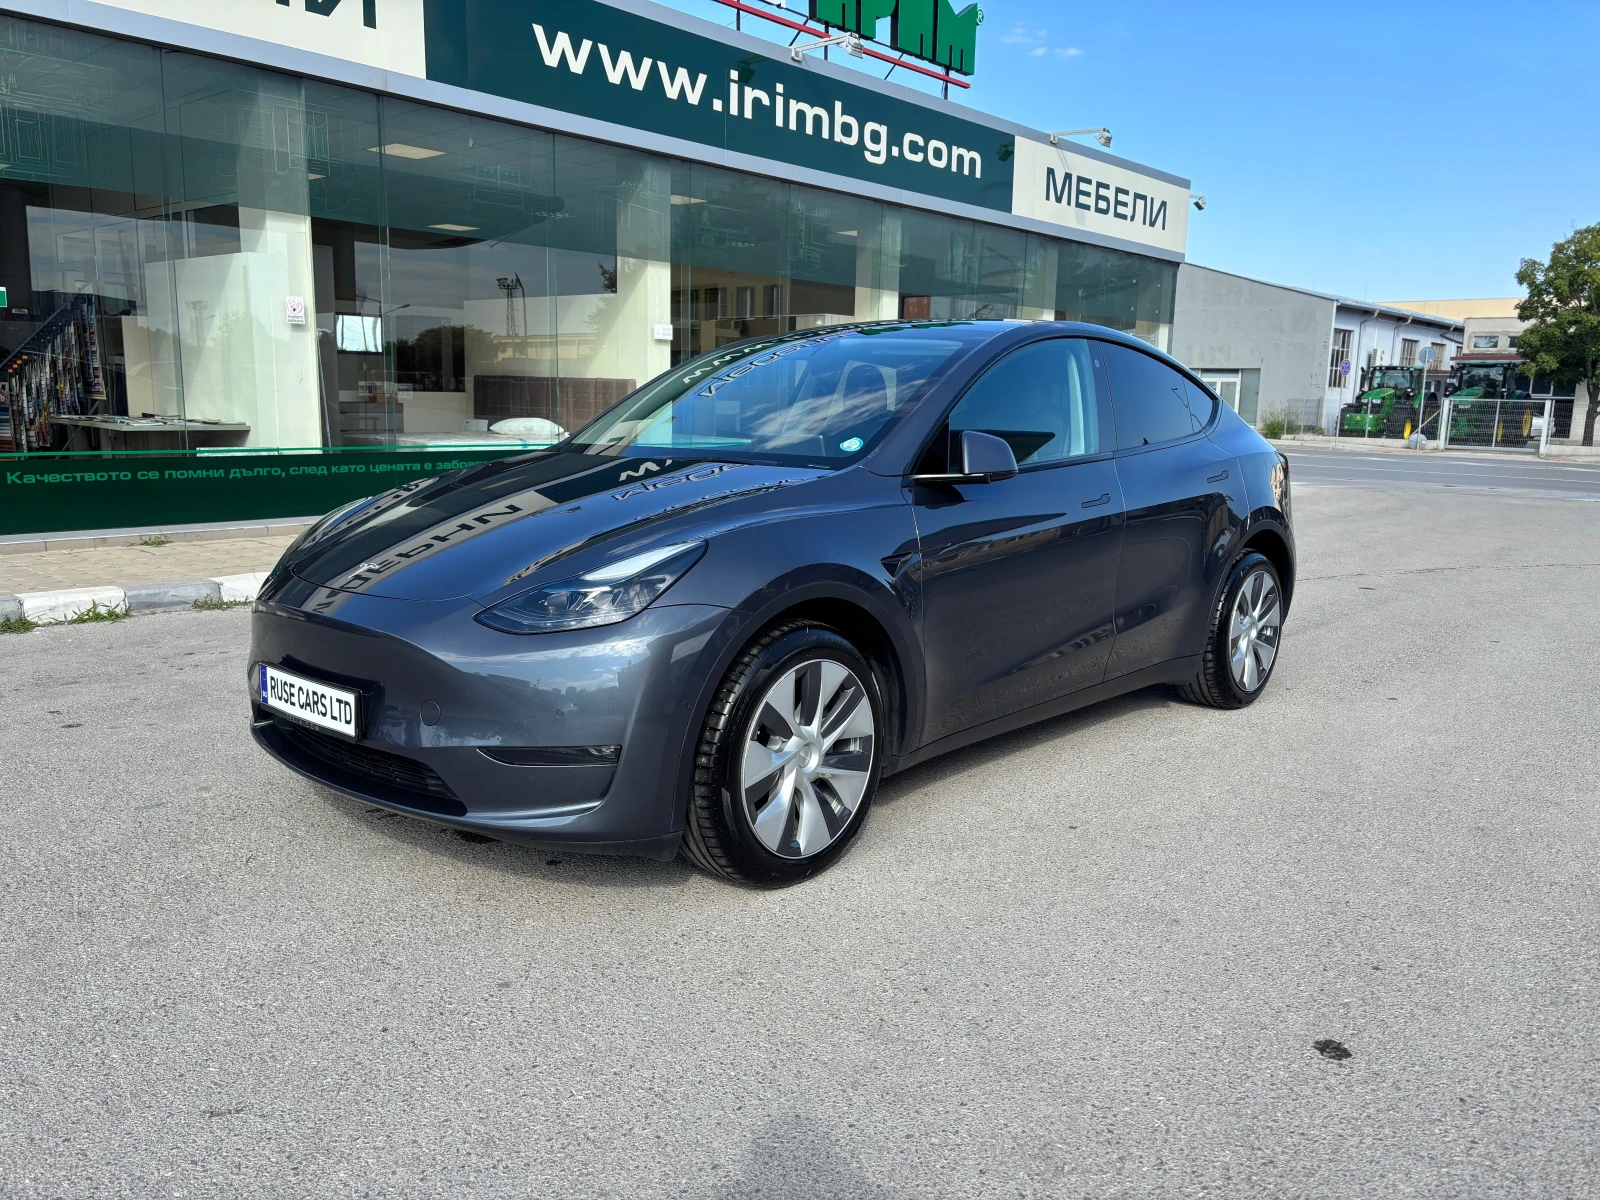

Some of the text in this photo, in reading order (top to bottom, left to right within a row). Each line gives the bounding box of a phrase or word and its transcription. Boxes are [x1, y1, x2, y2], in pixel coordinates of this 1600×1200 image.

[532, 23, 982, 179] www.irimbg.com
[1045, 166, 1168, 231] МЕБЕЛИ
[6, 471, 131, 484] Качеството
[137, 470, 160, 480] се
[164, 468, 225, 479] помни
[229, 467, 286, 479] дълго,
[289, 465, 328, 476] след
[331, 464, 366, 474] като
[369, 462, 420, 473] цената
[424, 462, 432, 470] е
[270, 675, 353, 725] RUSE CARS LTD
